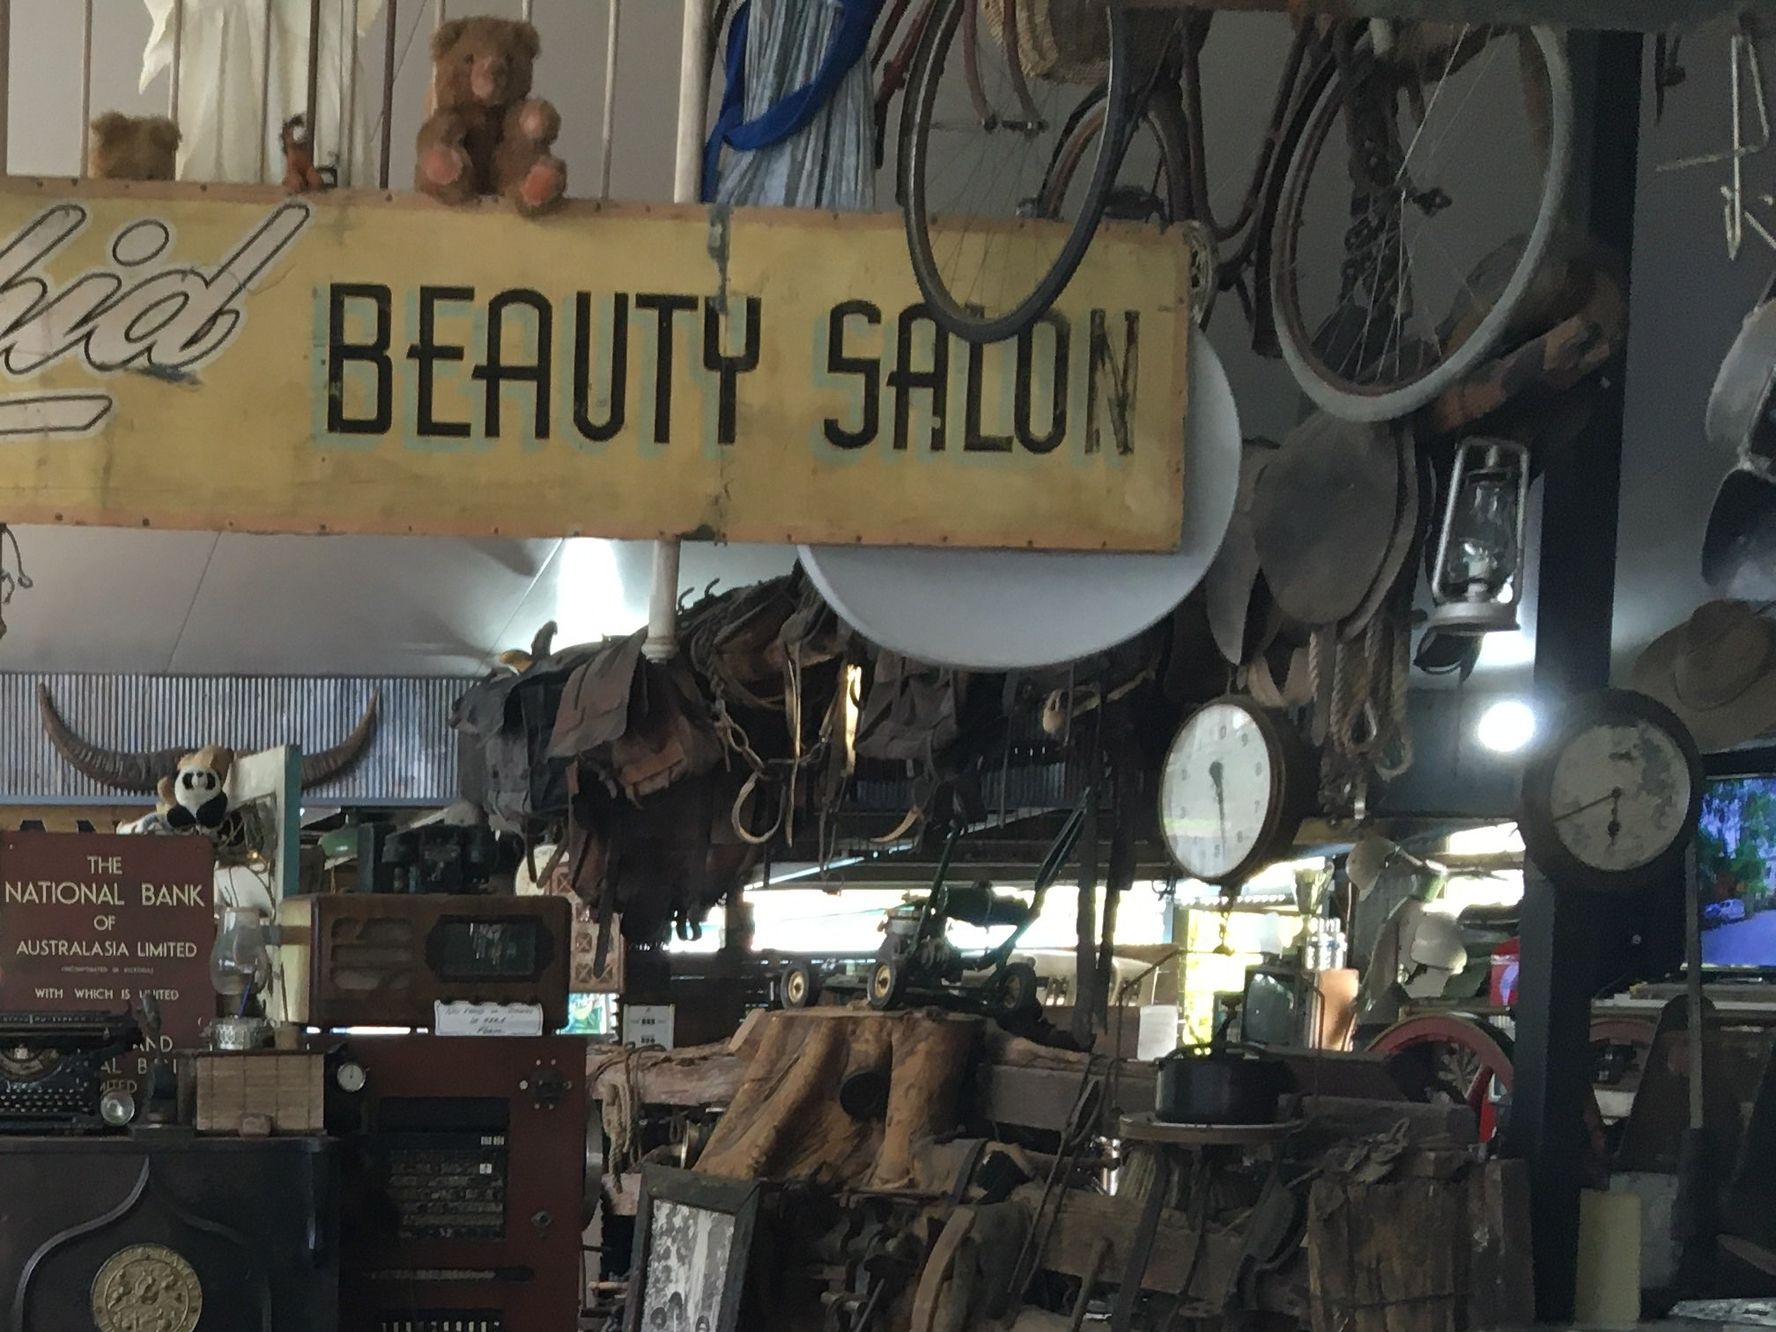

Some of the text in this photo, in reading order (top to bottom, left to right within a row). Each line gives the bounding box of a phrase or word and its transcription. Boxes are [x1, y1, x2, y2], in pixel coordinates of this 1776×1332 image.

[324, 281, 762, 447] BEAUTY
[824, 298, 1141, 457] SALON
[87, 855, 123, 875] THE
[4, 880, 206, 907] NATIONAL BANK
[93, 915, 116, 931] OF
[16, 940, 198, 958] AUSTRALASIA LIMITED
[35, 988, 180, 1001] WITH WHICH IS UITED
